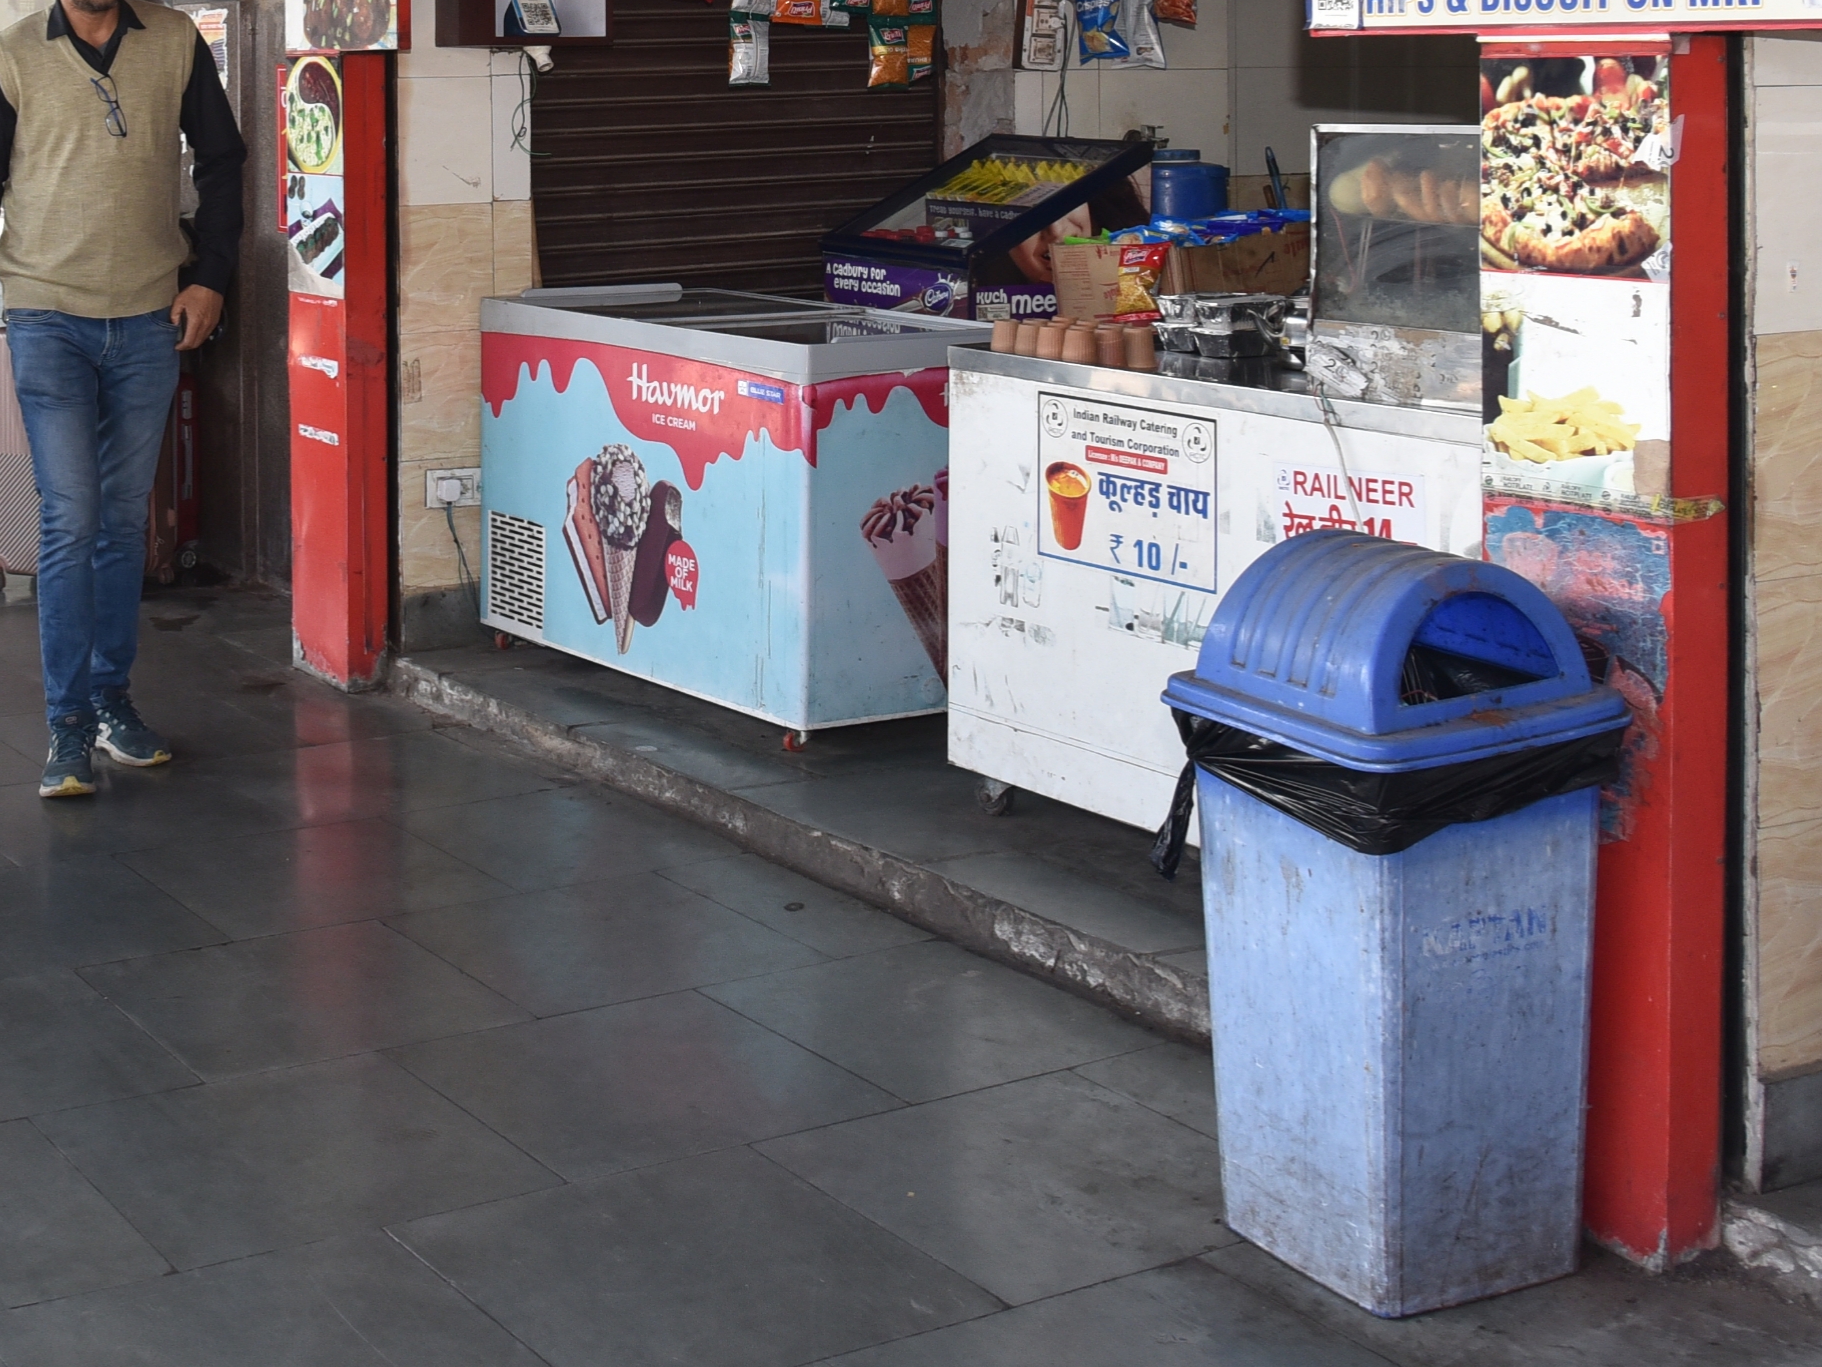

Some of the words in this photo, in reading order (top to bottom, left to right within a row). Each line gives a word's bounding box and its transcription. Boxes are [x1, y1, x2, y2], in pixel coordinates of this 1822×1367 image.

[825, 263, 832, 274] A
[870, 267, 887, 281] for
[833, 277, 860, 292] every
[861, 280, 901, 297] occasion
[1011, 291, 1057, 315] mee
[626, 362, 725, 416] Havmor
[749, 385, 766, 396] BLUE
[766, 387, 783, 401] STAR
[652, 413, 666, 426] ICE
[667, 415, 697, 432] CREAM
[1073, 407, 1100, 423] Indian
[1102, 413, 1138, 432] Railway
[1139, 419, 1178, 439] Catering
[1071, 430, 1088, 441] and
[1089, 432, 1125, 449] Tourism
[1127, 438, 1180, 458] Corporation
[1166, 484, 1211, 520] चाय
[668, 553, 696, 572] MADE
[1133, 538, 1162, 571] 10
[1170, 542, 1188, 575] /-
[674, 567, 689, 581] OF
[669, 577, 694, 593] MILK
